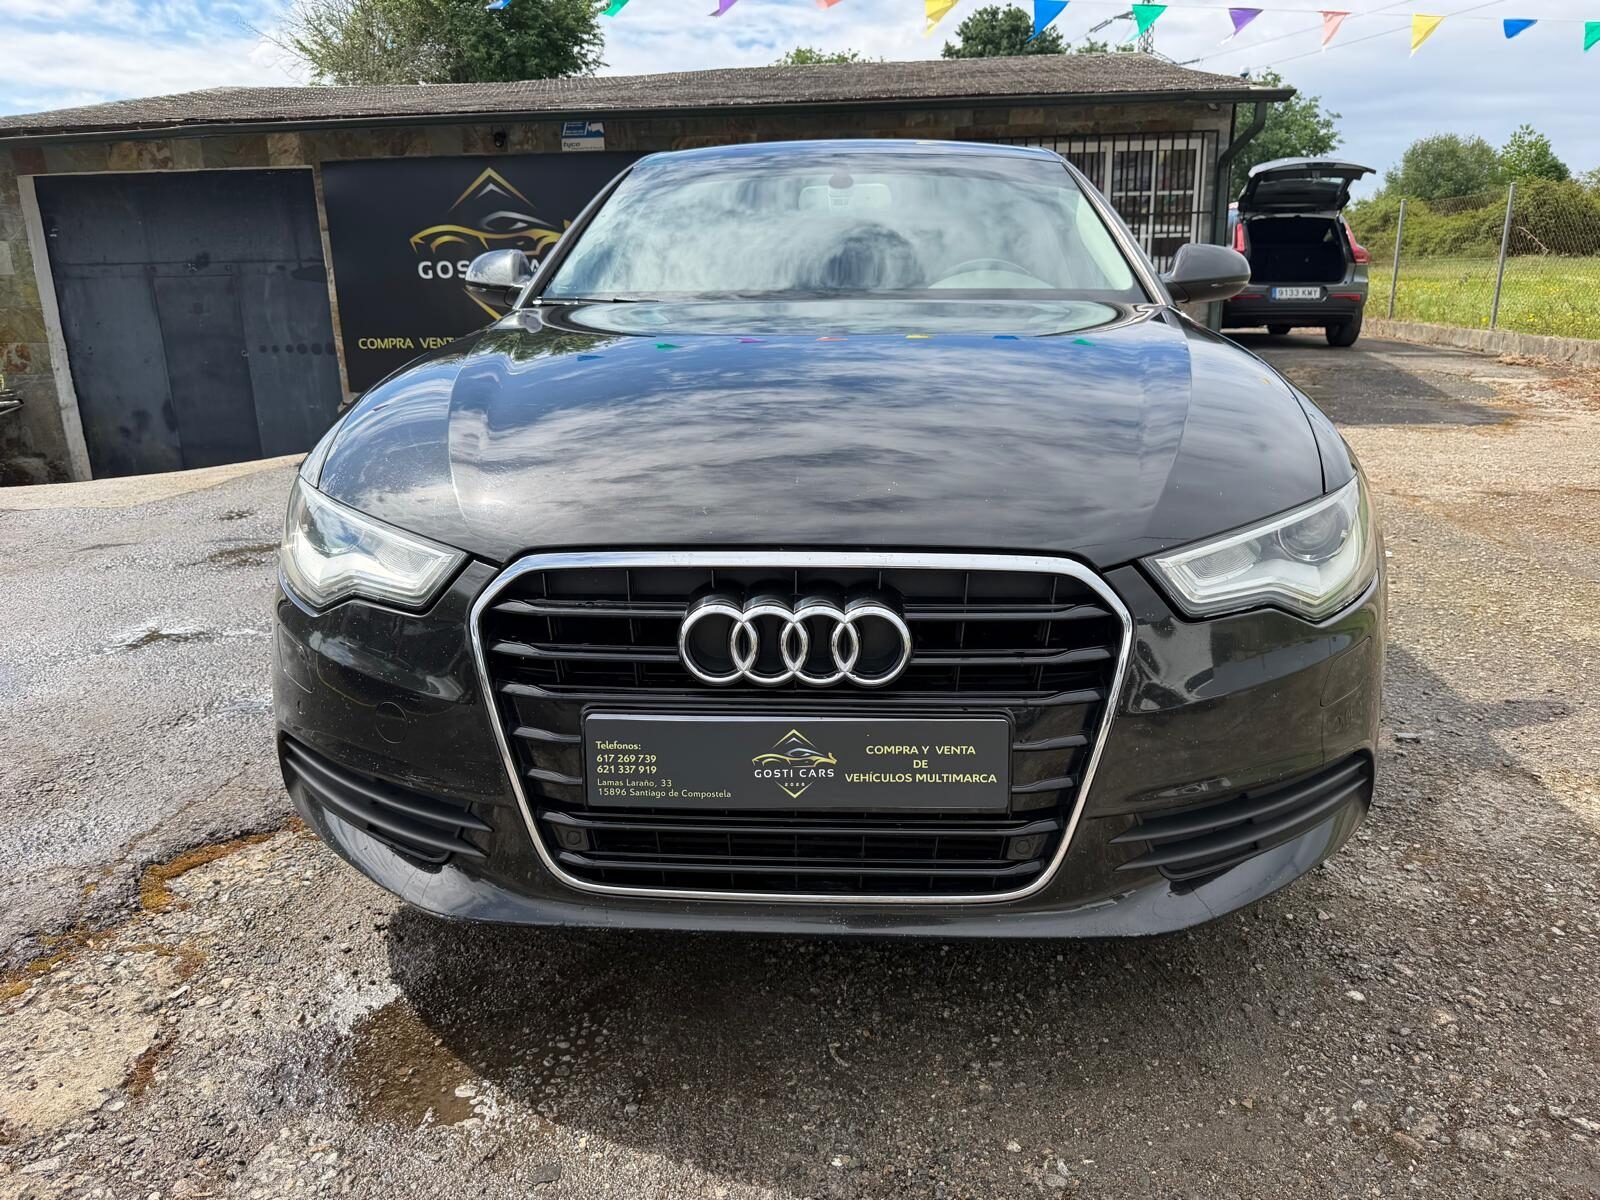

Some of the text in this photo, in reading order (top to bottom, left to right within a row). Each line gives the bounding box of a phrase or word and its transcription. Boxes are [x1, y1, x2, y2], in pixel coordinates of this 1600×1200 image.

[417, 261, 471, 279] GOS
[1278, 288, 1318, 297] 9133 KMY
[358, 336, 455, 349] COMPRA VENT
[595, 740, 641, 750] Telefonos:
[865, 745, 976, 755] COMPRA Y VENTA
[596, 754, 657, 763] 617 269 739
[913, 759, 929, 769] DE
[596, 765, 657, 774] 621 337 919
[754, 768, 835, 778] GOSTI CARS
[844, 771, 998, 783] VEHÍCULOS MULTIMARCA
[597, 778, 624, 786] Lamas
[660, 779, 672, 787] 33
[598, 788, 732, 800] 15896 Santiago de Compostela
